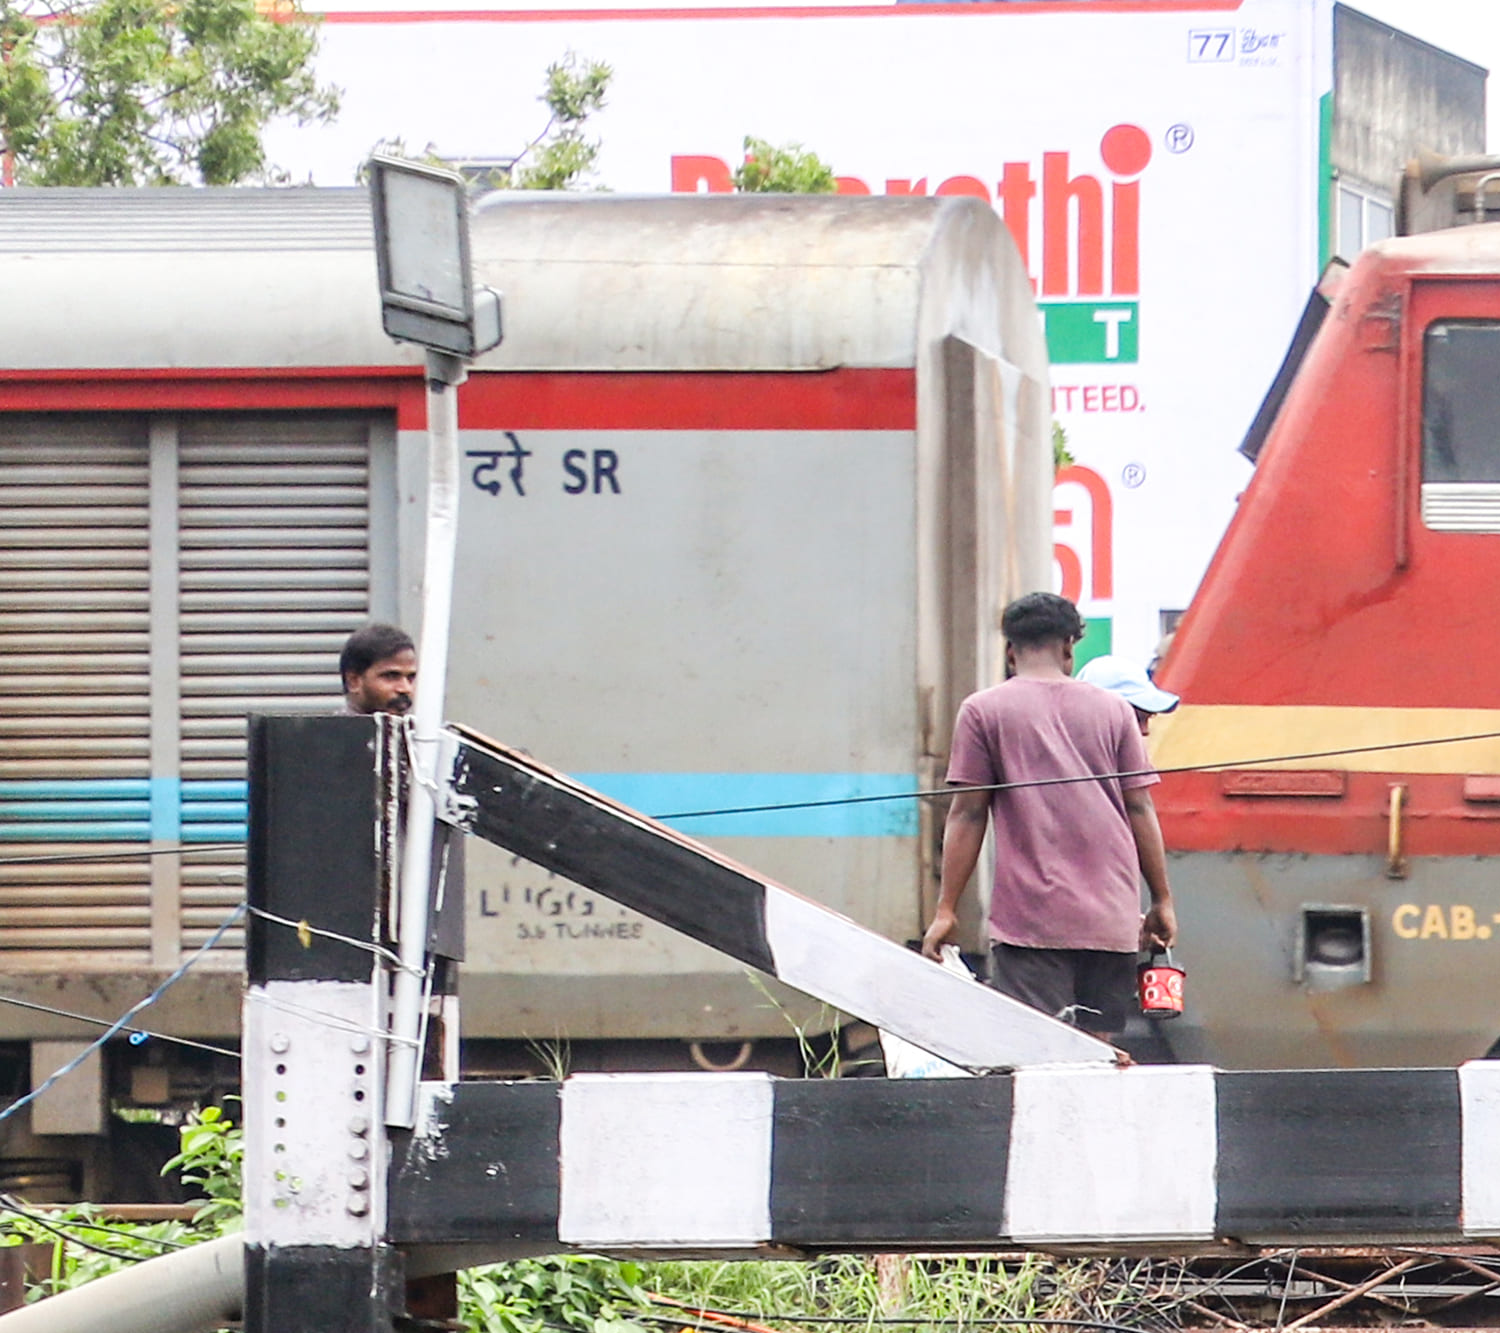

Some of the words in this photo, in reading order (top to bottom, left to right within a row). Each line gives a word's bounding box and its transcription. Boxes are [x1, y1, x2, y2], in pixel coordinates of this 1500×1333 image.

[1193, 33, 1231, 58] 77
[465, 431, 533, 497] दरे
[562, 448, 622, 495] SR
